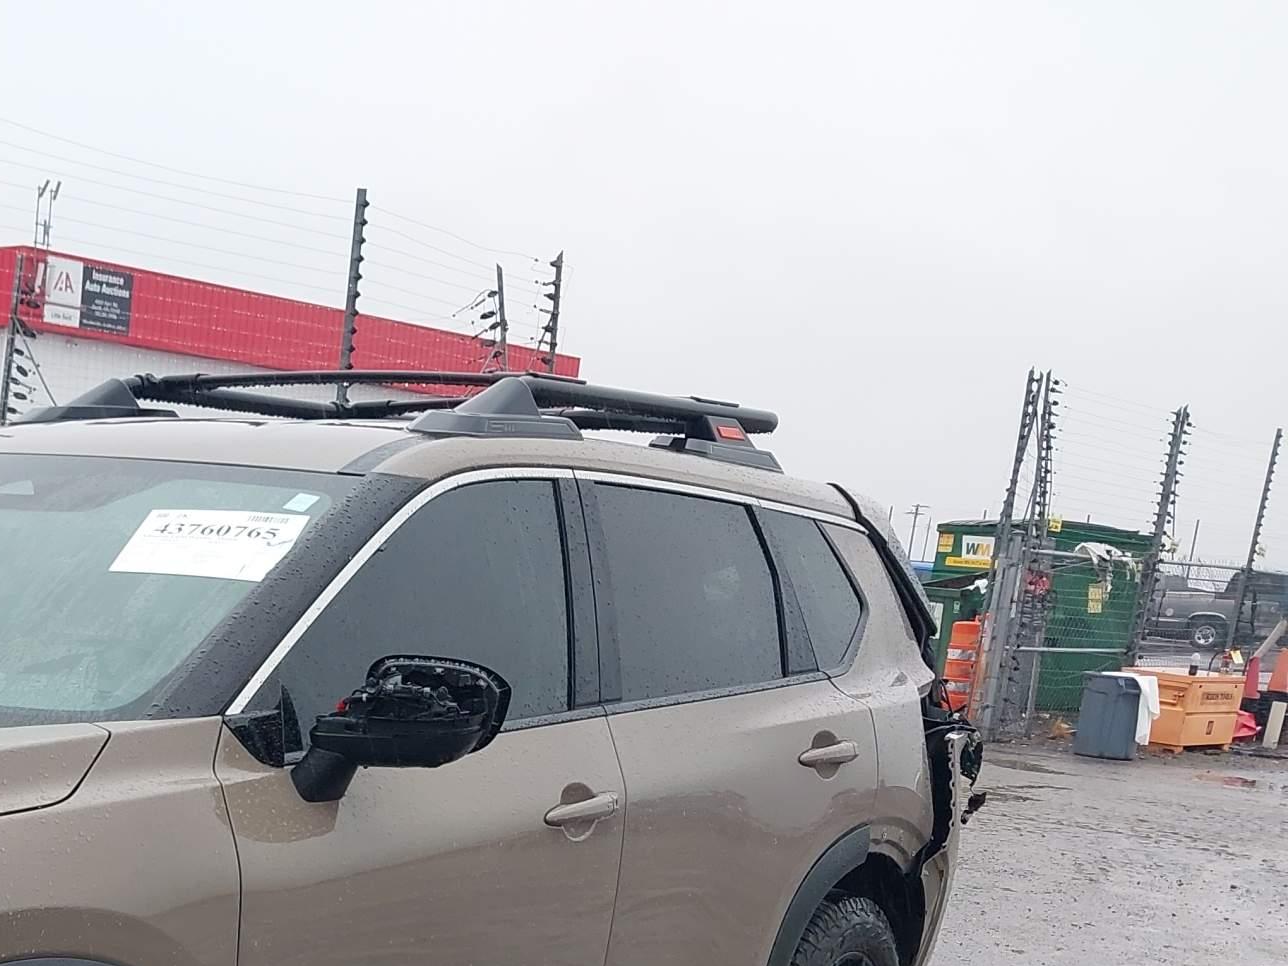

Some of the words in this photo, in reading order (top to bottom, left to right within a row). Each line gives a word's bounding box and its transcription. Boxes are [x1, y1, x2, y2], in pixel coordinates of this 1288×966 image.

[92, 269, 124, 286] Insurance
[85, 279, 101, 293] Auto
[101, 283, 130, 298] Auctions
[153, 523, 281, 540] 43760765
[966, 542, 991, 556] WM
